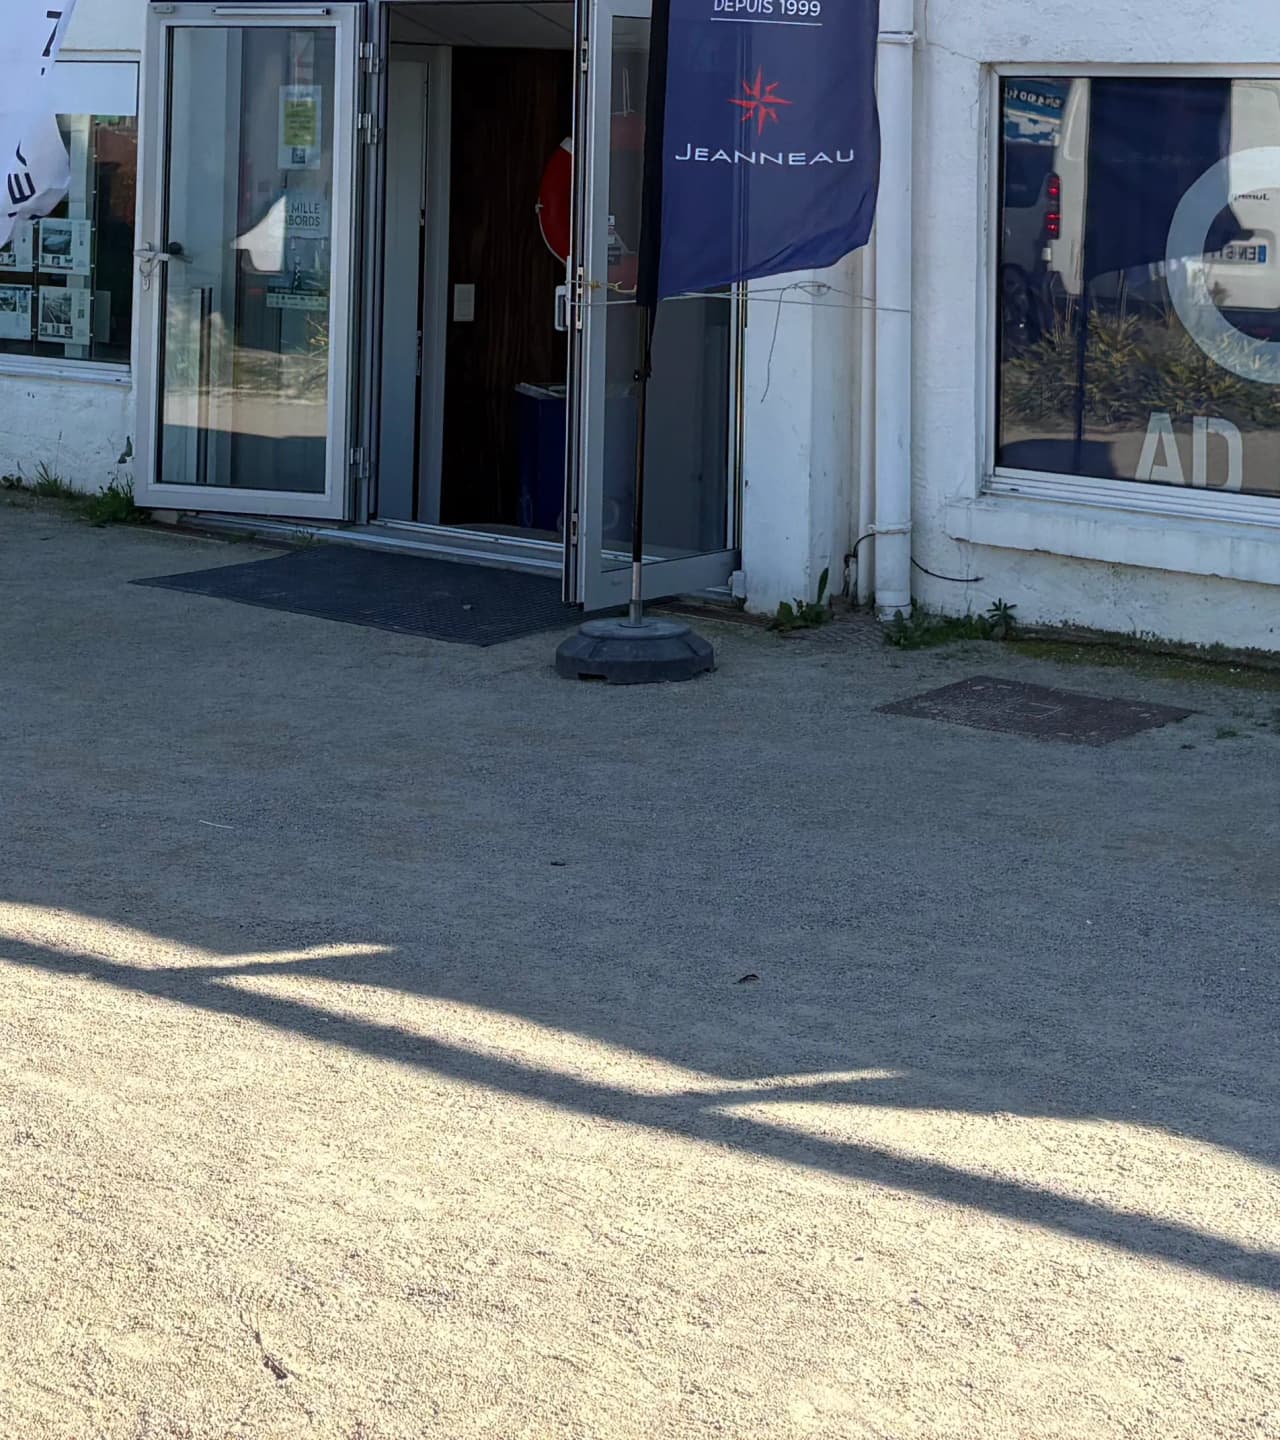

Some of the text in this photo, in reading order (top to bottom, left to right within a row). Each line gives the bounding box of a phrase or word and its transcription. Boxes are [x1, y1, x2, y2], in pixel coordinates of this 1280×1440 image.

[675, 144, 854, 166] JEANNEAU
[291, 203, 320, 215] MILLE
[1136, 412, 1243, 493] AD
